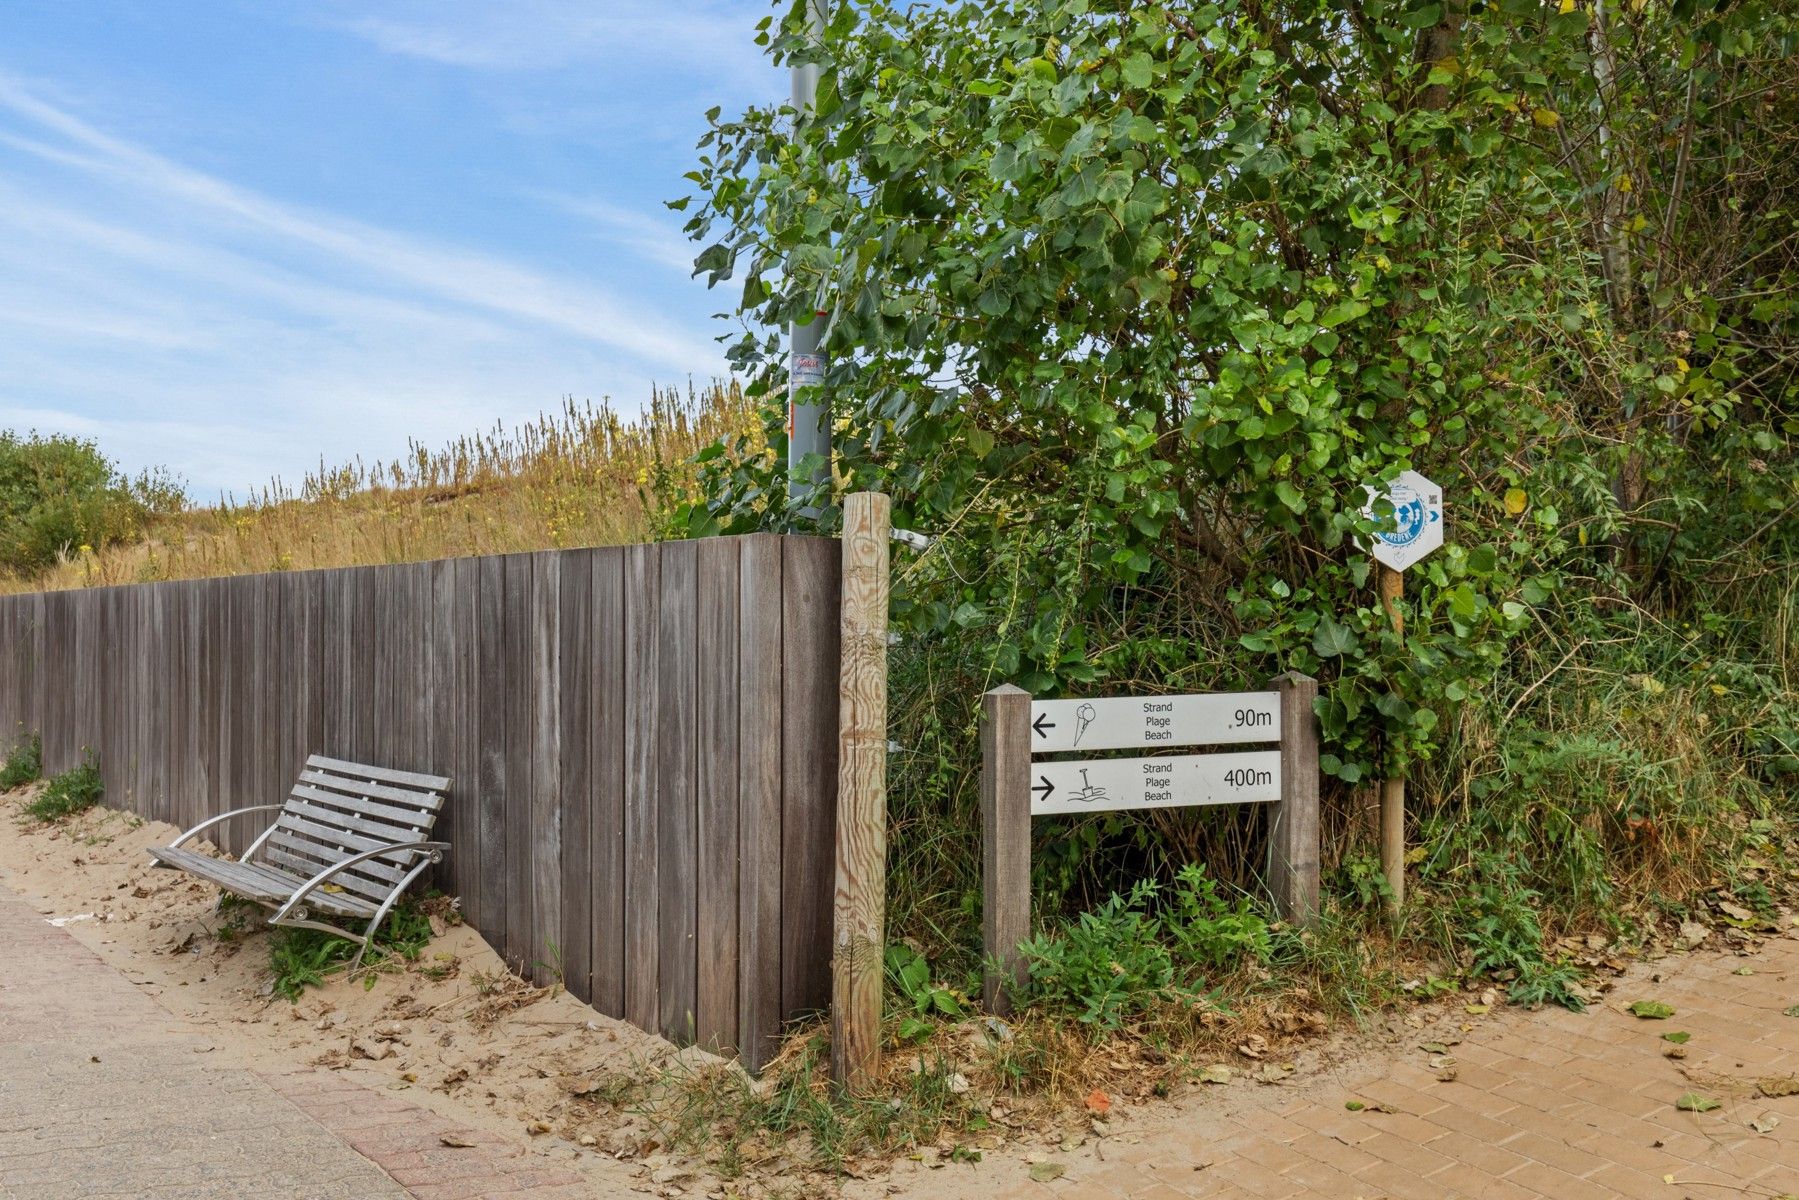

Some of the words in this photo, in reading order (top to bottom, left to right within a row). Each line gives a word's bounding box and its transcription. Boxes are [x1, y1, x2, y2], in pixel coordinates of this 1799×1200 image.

[1143, 702, 1172, 713] Strand
[1146, 716, 1171, 727] Plage
[1235, 708, 1272, 727] 90m
[1145, 730, 1172, 740] Beach
[1143, 763, 1172, 774] Strand
[1146, 777, 1171, 788] Plage
[1223, 768, 1272, 787] 400m
[1145, 791, 1172, 801] Beach
